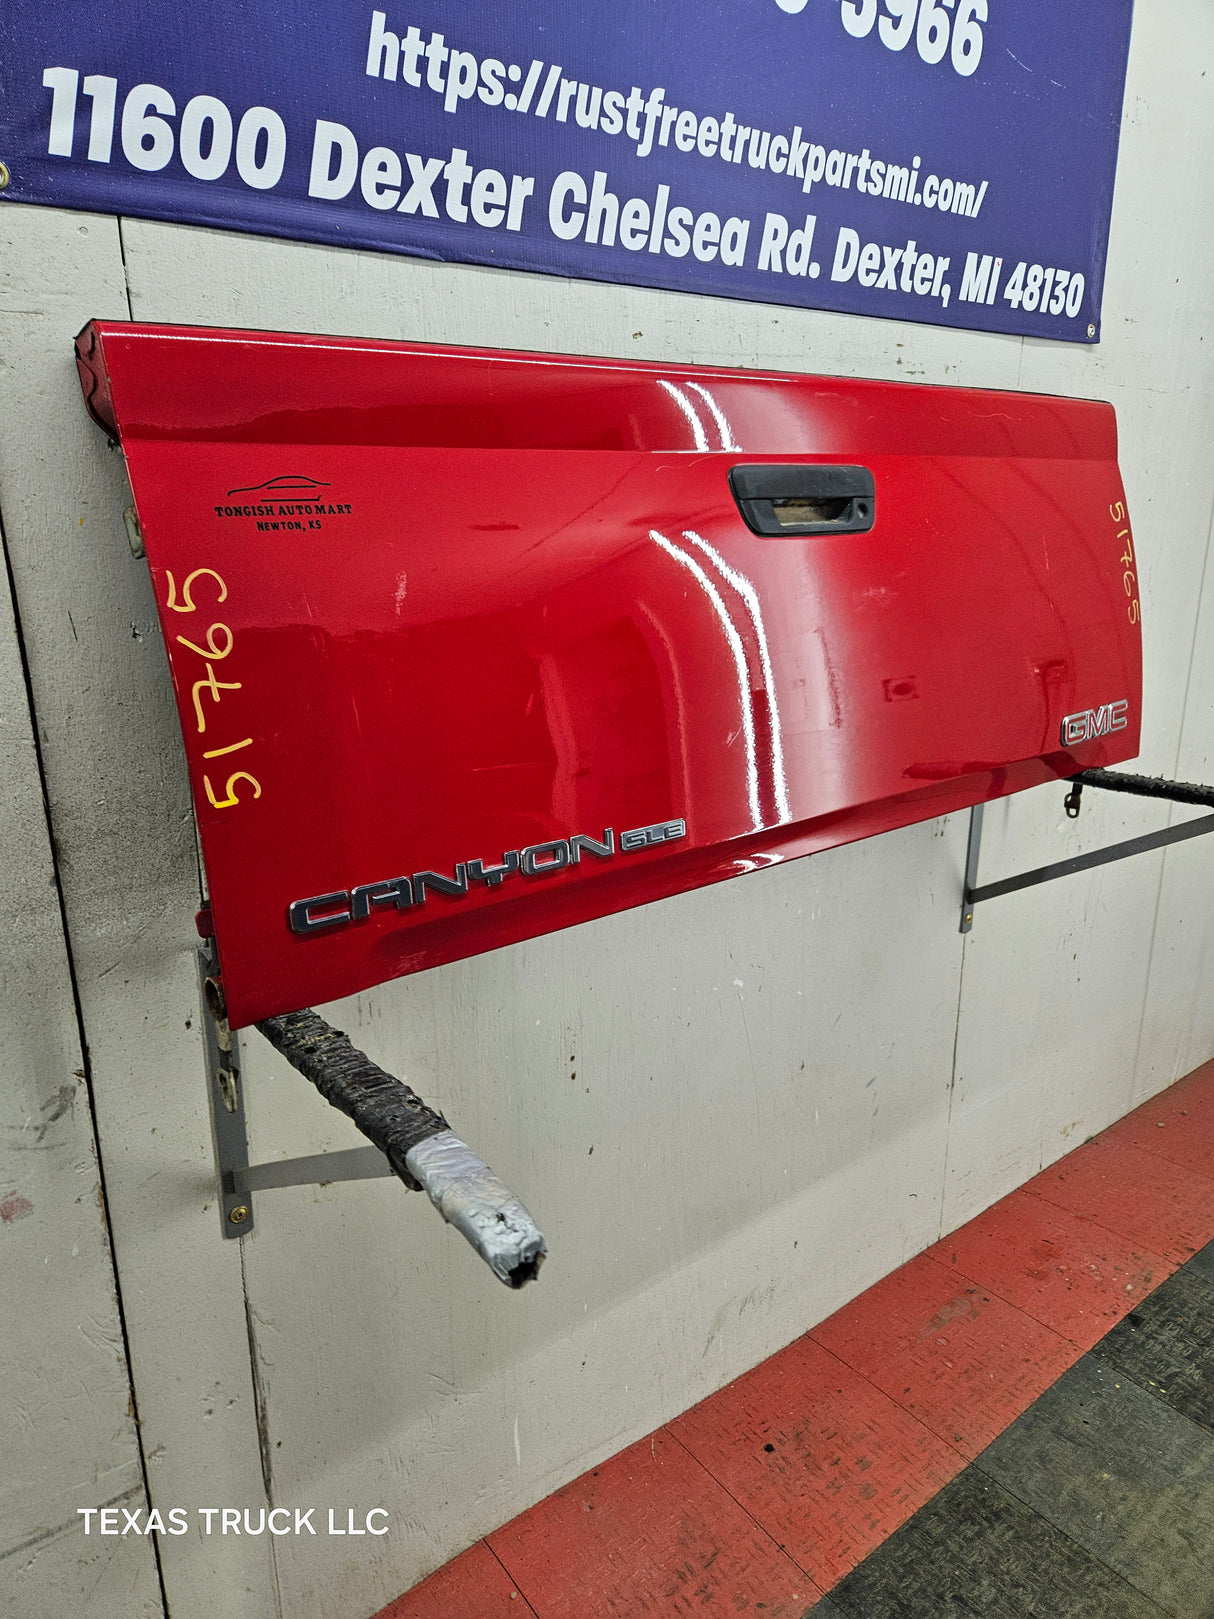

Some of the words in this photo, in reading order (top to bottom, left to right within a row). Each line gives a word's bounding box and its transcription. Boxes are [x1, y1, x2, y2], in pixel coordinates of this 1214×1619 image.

[366, 10, 988, 218] https://rustfreetruckpartsmi.com/
[42, 67, 287, 190] 11600
[308, 119, 535, 231] Dexter
[548, 170, 750, 267] Chelsea
[757, 212, 820, 279] Rd.
[831, 226, 951, 308] Dexter,
[962, 252, 1001, 305] MI
[1003, 261, 1084, 318] 48130
[214, 505, 275, 517] TONGISH
[278, 504, 313, 516] AUTO
[314, 503, 352, 515] MART
[256, 521, 306, 532] NEWTON,
[308, 519, 322, 530] KS
[1110, 501, 1140, 625] 51765
[166, 568, 262, 809] 51765
[1060, 699, 1129, 747] GMC
[288, 826, 616, 936] CANYON
[624, 819, 684, 849] SLE
